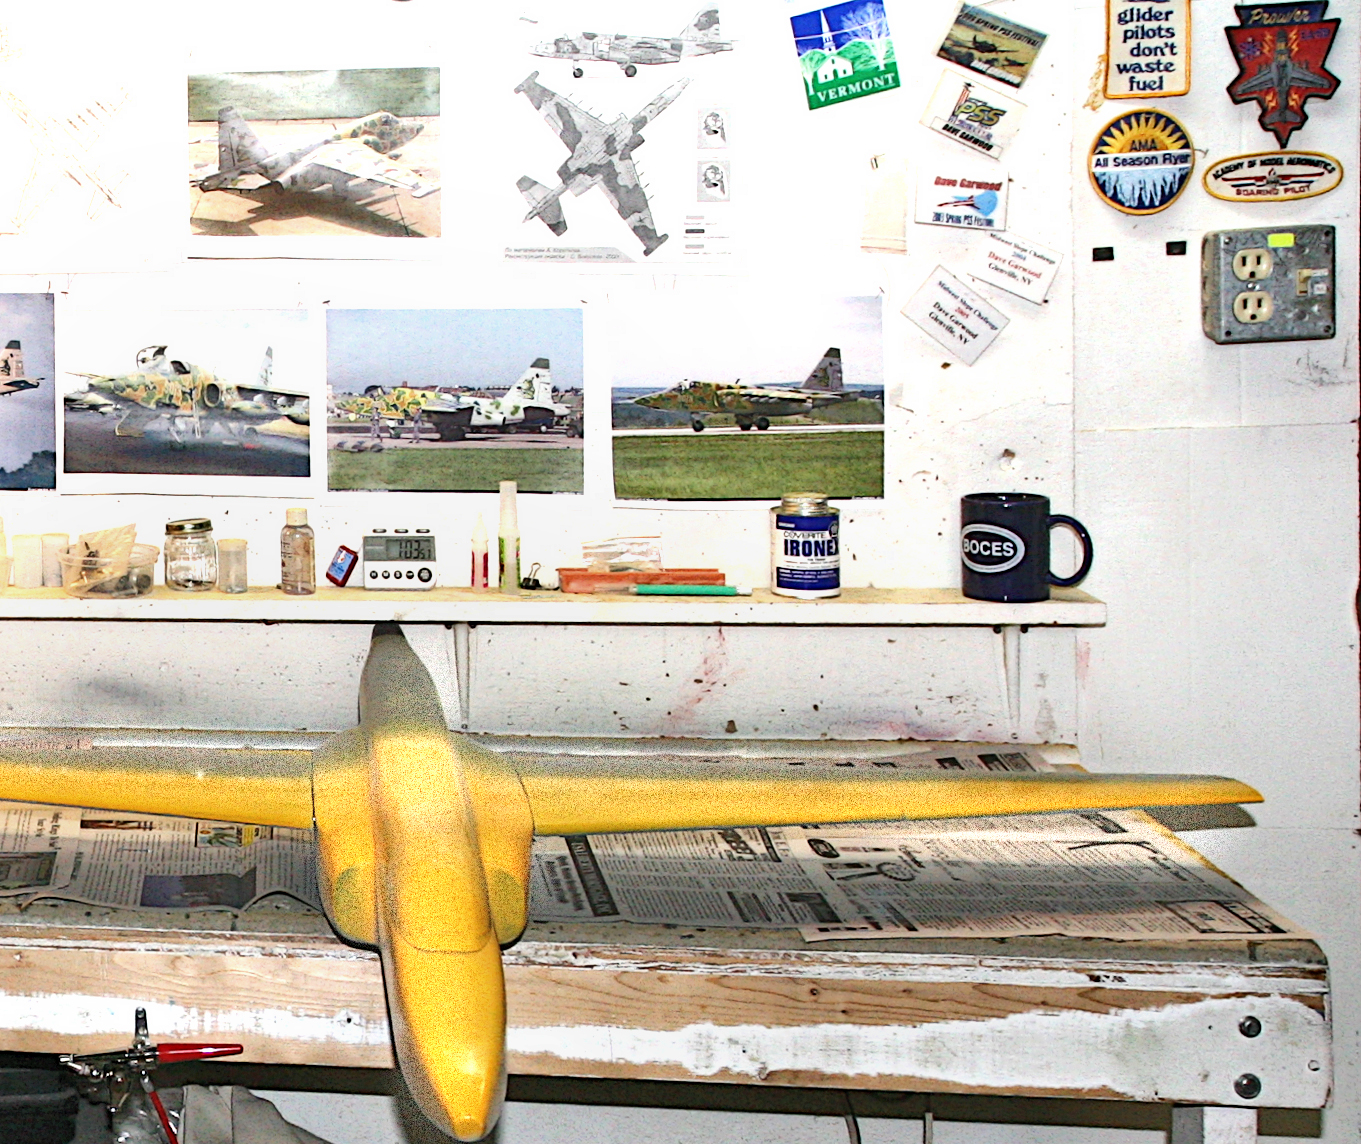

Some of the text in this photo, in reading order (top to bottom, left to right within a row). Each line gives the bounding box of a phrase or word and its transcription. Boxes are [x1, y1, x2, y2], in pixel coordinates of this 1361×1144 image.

[1117, 7, 1174, 25] glider
[1248, 8, 1311, 26] Prowler
[1122, 25, 1176, 43] pilots
[1130, 42, 1178, 58] don't
[1116, 59, 1176, 75] waste
[817, 73, 895, 102] VERMONT
[1128, 76, 1165, 92] fuel
[954, 102, 1008, 127] PSS
[942, 123, 961, 136] DAVE
[958, 130, 994, 152] GARWOOD
[1130, 138, 1158, 150] AMA
[1094, 152, 1192, 168] All Season Flyer
[1212, 157, 1337, 181] ACADEMY OF MODEL AERONAUTICS
[934, 176, 1003, 192] Dave Garwood
[1235, 183, 1311, 196] SOARING PILOT
[988, 251, 1042, 279] Dave Garwood
[1021, 274, 1034, 287] NY
[932, 301, 979, 340] Dave Garwood
[958, 333, 970, 346] NY
[783, 530, 826, 539] COVERITE
[963, 538, 1015, 557] BOCES
